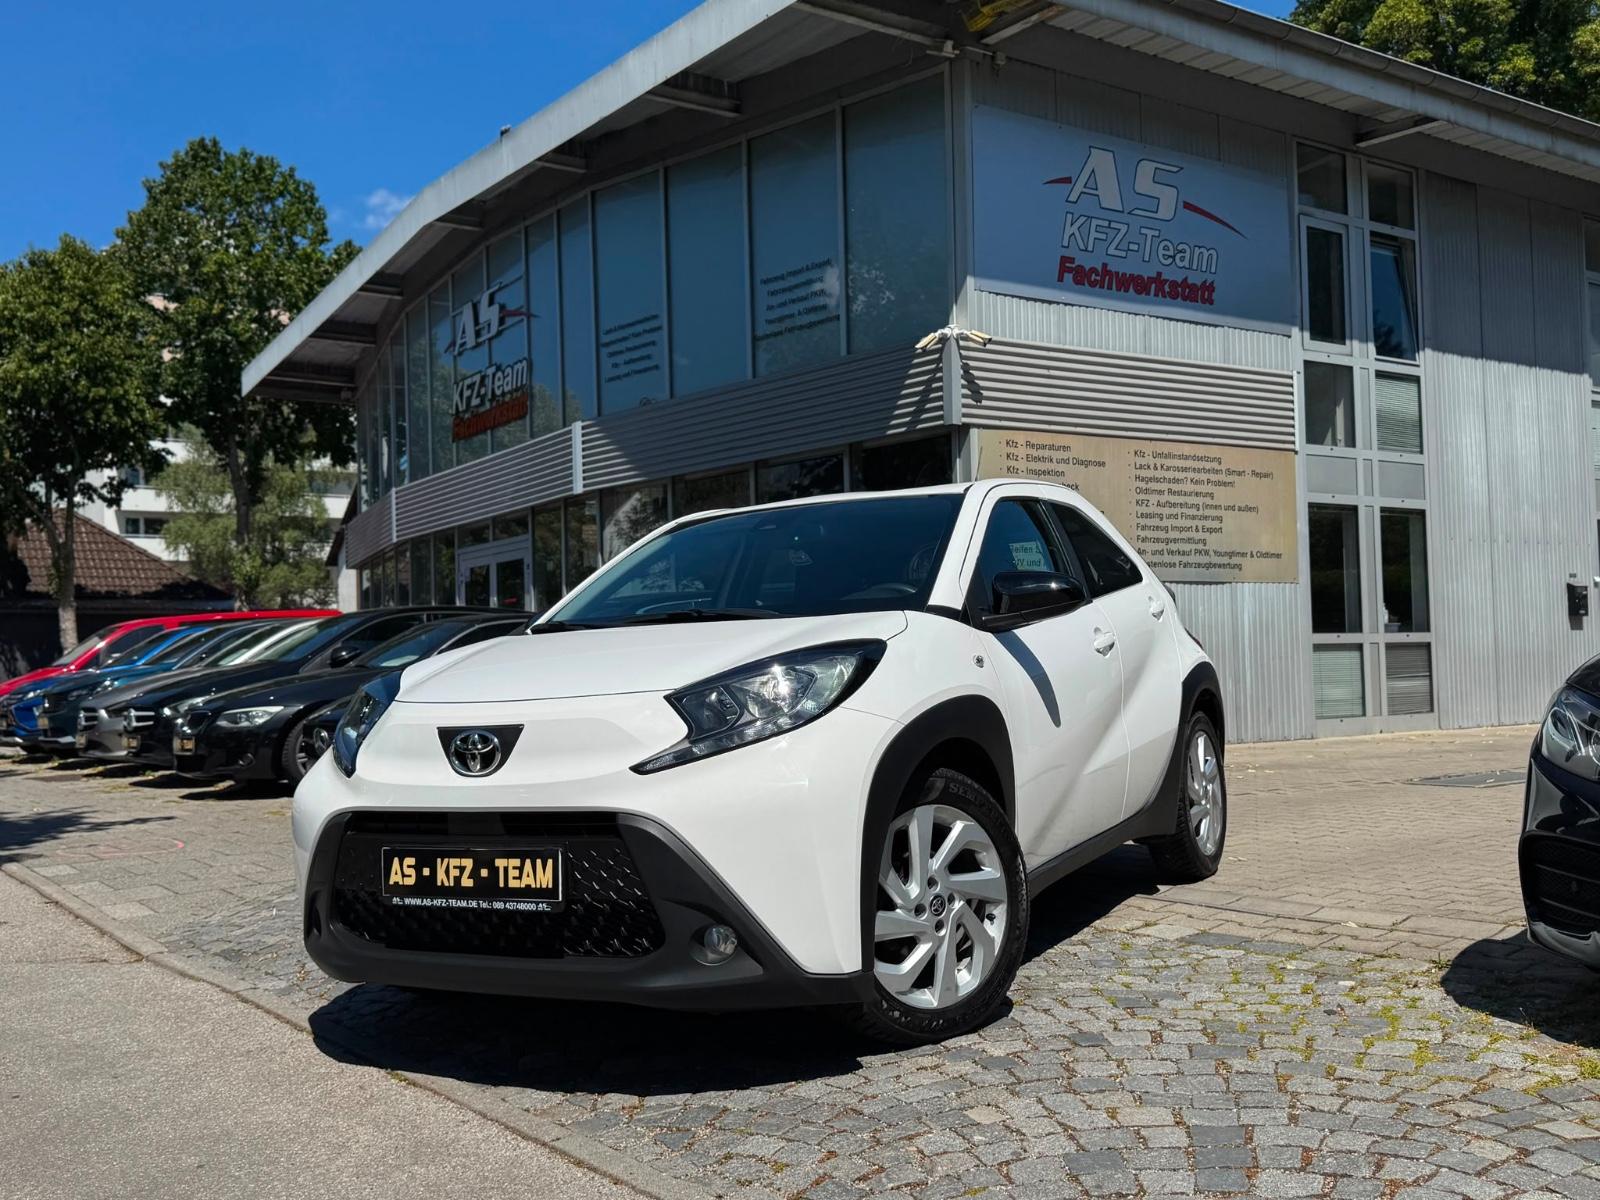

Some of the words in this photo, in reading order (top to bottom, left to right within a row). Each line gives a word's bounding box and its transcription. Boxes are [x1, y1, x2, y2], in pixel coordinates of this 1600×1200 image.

[1065, 145, 1184, 222] AS
[1061, 211, 1219, 274] KFZ-Team
[1057, 255, 1216, 305] Fachwerkstatt
[453, 282, 502, 355] AS
[451, 359, 528, 415] KFZ-Team
[1005, 440, 1018, 448] Kfz
[1025, 441, 1071, 452] Reparaturen
[1006, 453, 1019, 461] Kfz
[1026, 454, 1055, 463] Elektrik
[1056, 456, 1070, 465] und
[1072, 457, 1106, 469] Diagnose
[1134, 450, 1146, 458] Kfz
[1152, 450, 1222, 465] Unfallinstandsetzung
[1006, 466, 1019, 475] Kfz
[1026, 467, 1066, 478] Inspektion
[1134, 463, 1151, 471] Lack
[1153, 463, 1159, 471] &
[1160, 463, 1223, 476] Karosseriearbeiten
[1224, 468, 1246, 478] (Smart
[1251, 470, 1274, 480] Repair)
[1135, 474, 1188, 485] Hagelschaden?
[1190, 477, 1205, 486] Kein
[1206, 478, 1236, 488] Problem!
[1135, 486, 1166, 496] Oldtimer
[1167, 488, 1215, 500] Restaurierung
[1135, 499, 1150, 507] KFZ
[1156, 500, 1200, 511] Aufbereitung
[1202, 501, 1222, 512] (innen
[1223, 502, 1236, 512] und
[1237, 503, 1259, 514] außen)
[1136, 511, 1164, 521] Leasing
[1165, 512, 1179, 520] und
[1180, 512, 1223, 524] Finanzierung
[1136, 523, 1169, 534] Fahrzeug
[1170, 523, 1193, 534] Import
[1194, 524, 1200, 532] &
[1201, 525, 1223, 534] Export
[1136, 535, 1207, 547] Fahrzeugvermittlung
[1137, 547, 1150, 556] An-
[1151, 547, 1165, 556] und
[1166, 548, 1193, 557] Verkauf
[1194, 549, 1211, 558] PKW,
[1213, 550, 1248, 560] Youngtimer
[1249, 551, 1255, 559] &
[1256, 551, 1283, 560] Oldtimer
[1147, 561, 1177, 569] stenlose
[1178, 561, 1243, 571] Fahrzeugbewertung
[388, 856, 416, 885] AS
[436, 857, 474, 887] KFZ
[495, 858, 553, 889] TEAM
[404, 897, 478, 908] WWW.AS-KFZ-TEAM.DE
[479, 900, 492, 909] Tel.:
[493, 901, 505, 909] 089
